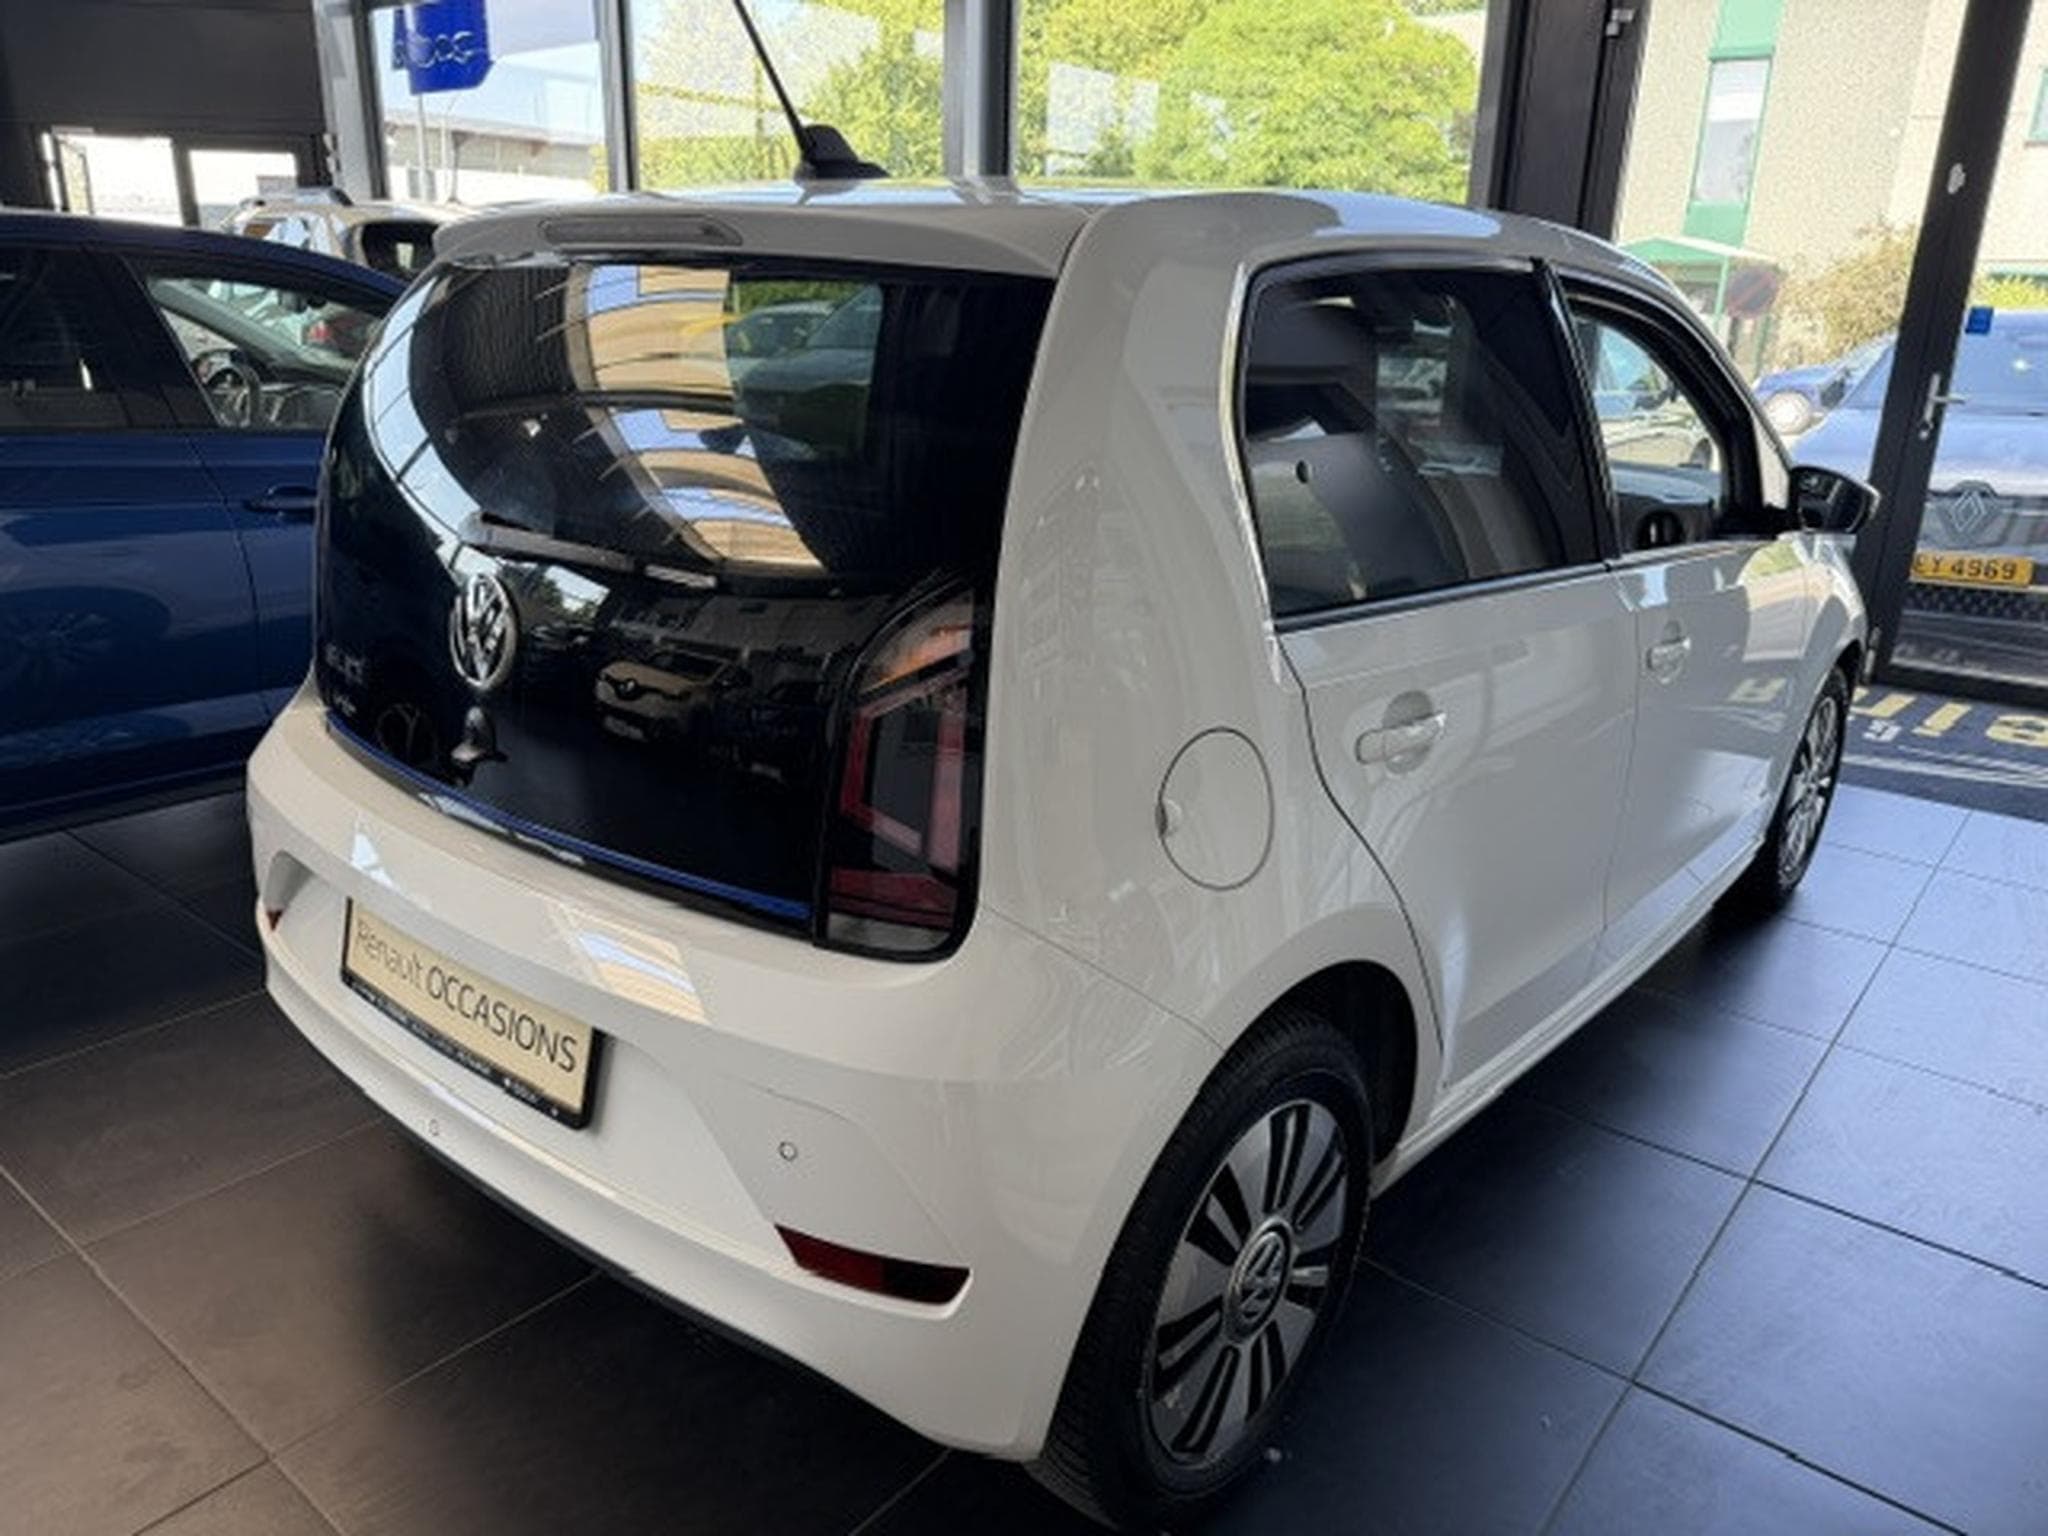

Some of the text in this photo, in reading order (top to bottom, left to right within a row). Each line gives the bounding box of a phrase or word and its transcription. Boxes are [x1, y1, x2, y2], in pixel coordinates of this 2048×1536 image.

[1950, 557, 2018, 581] 4969
[355, 917, 578, 1074] Renault OCCASIONS
